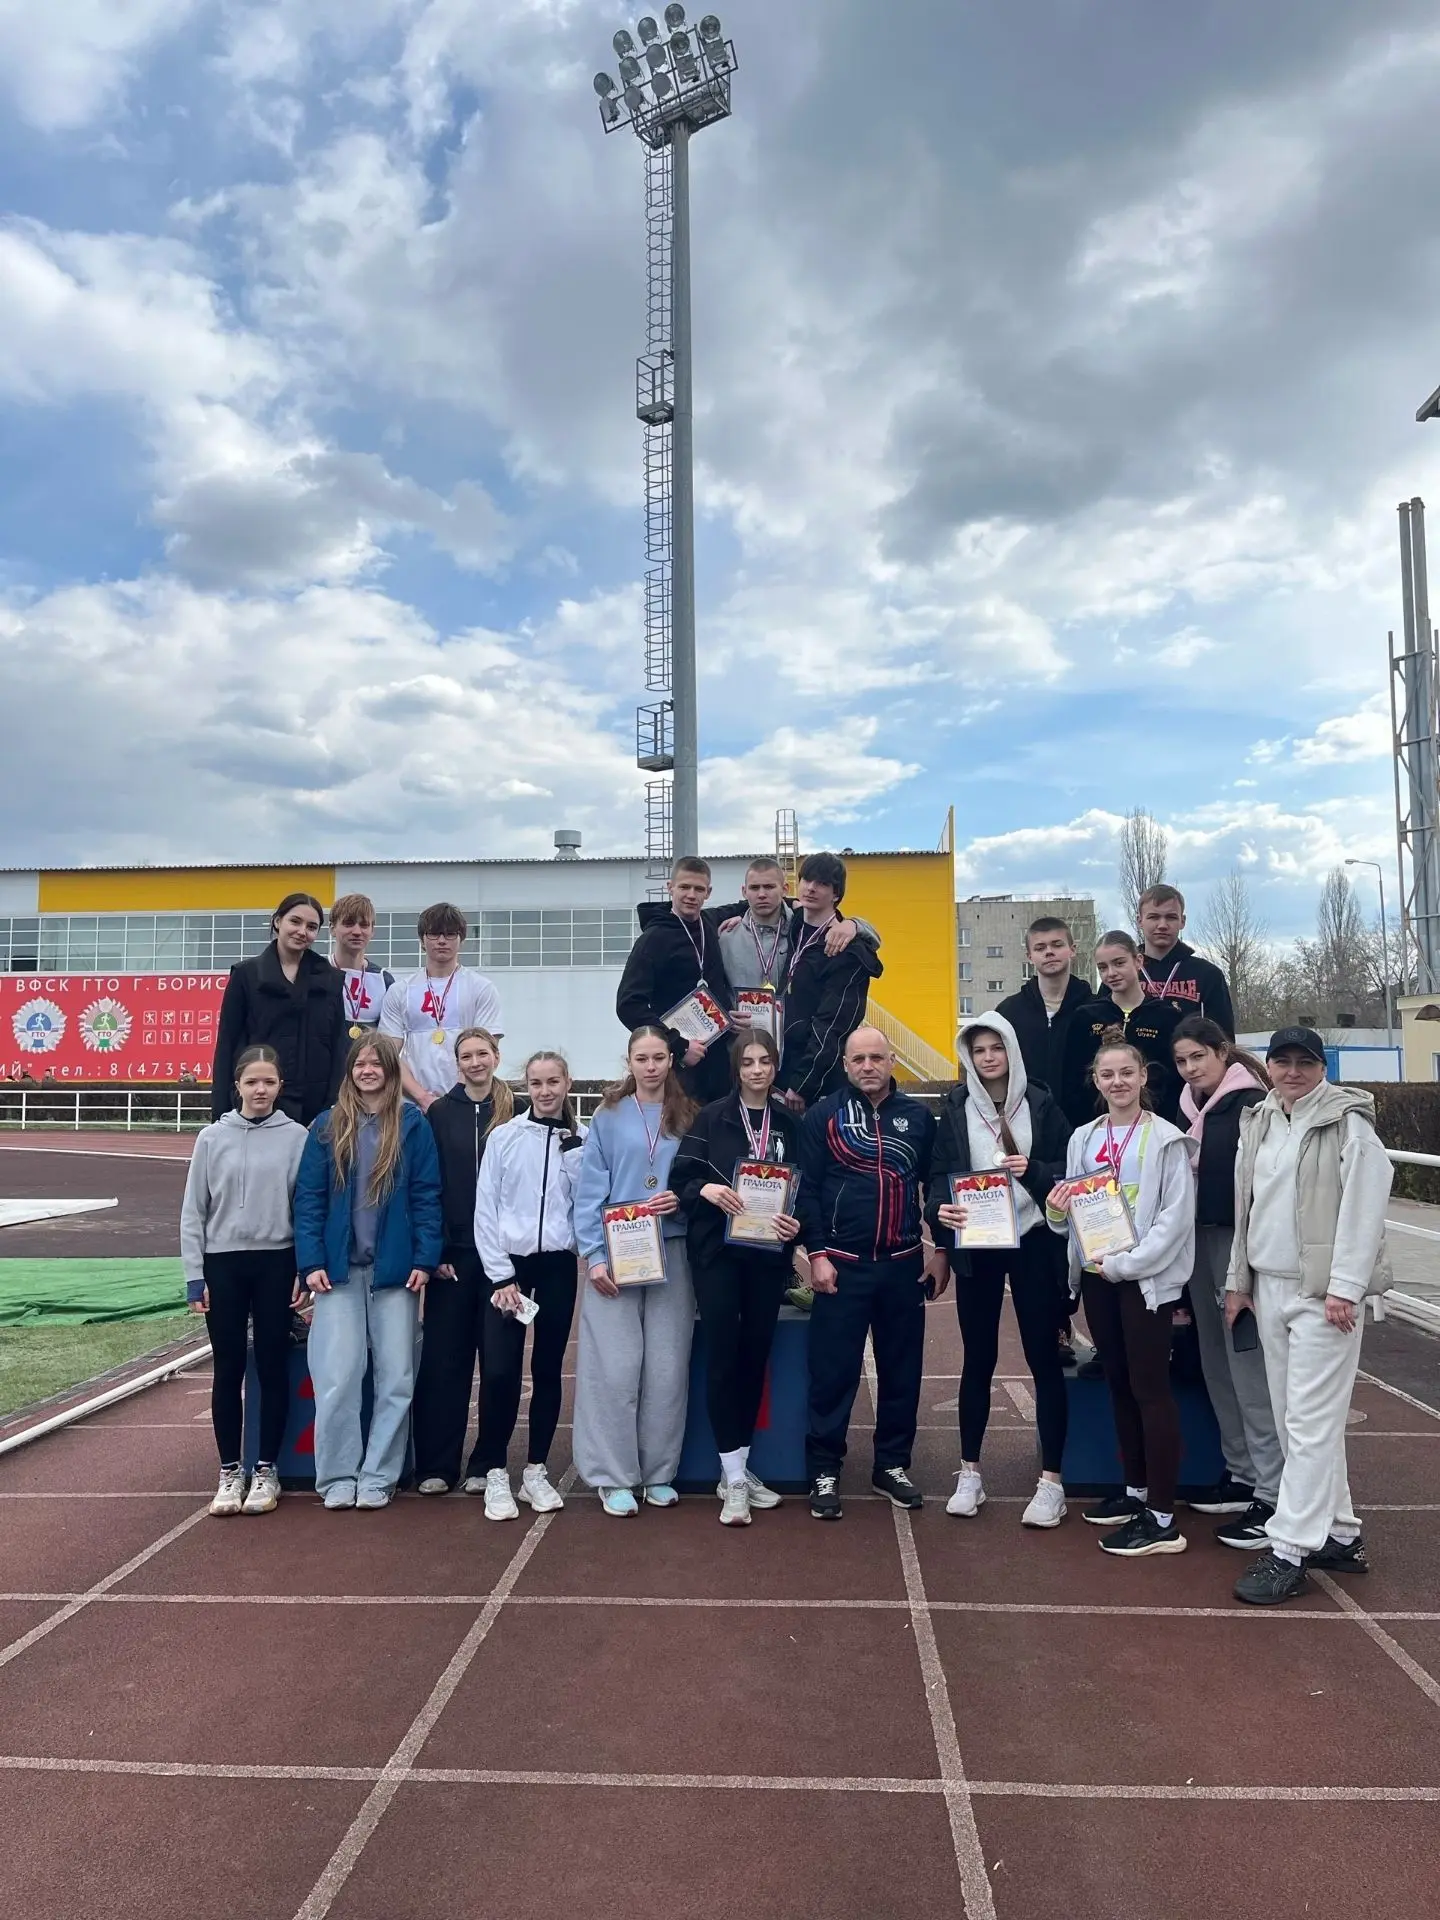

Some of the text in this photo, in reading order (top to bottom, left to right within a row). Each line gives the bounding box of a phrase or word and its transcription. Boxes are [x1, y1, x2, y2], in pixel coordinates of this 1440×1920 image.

[16, 976, 226, 992] ВФСК ГТО Г. БОРИС
[345, 977, 372, 1009] 4
[420, 990, 446, 1021] 4
[740, 1004, 770, 1014] ГРАМОТА
[689, 1001, 715, 1033] ГРАМОТА
[110, 1063, 118, 1076] 8
[1094, 1138, 1121, 1168] 4
[743, 1178, 783, 1190] ГРАМОТА
[962, 1190, 1005, 1203] ГРАМОТА
[1073, 1189, 1112, 1208] ГРАМОТ
[612, 1220, 652, 1233] ГРАМОТА
